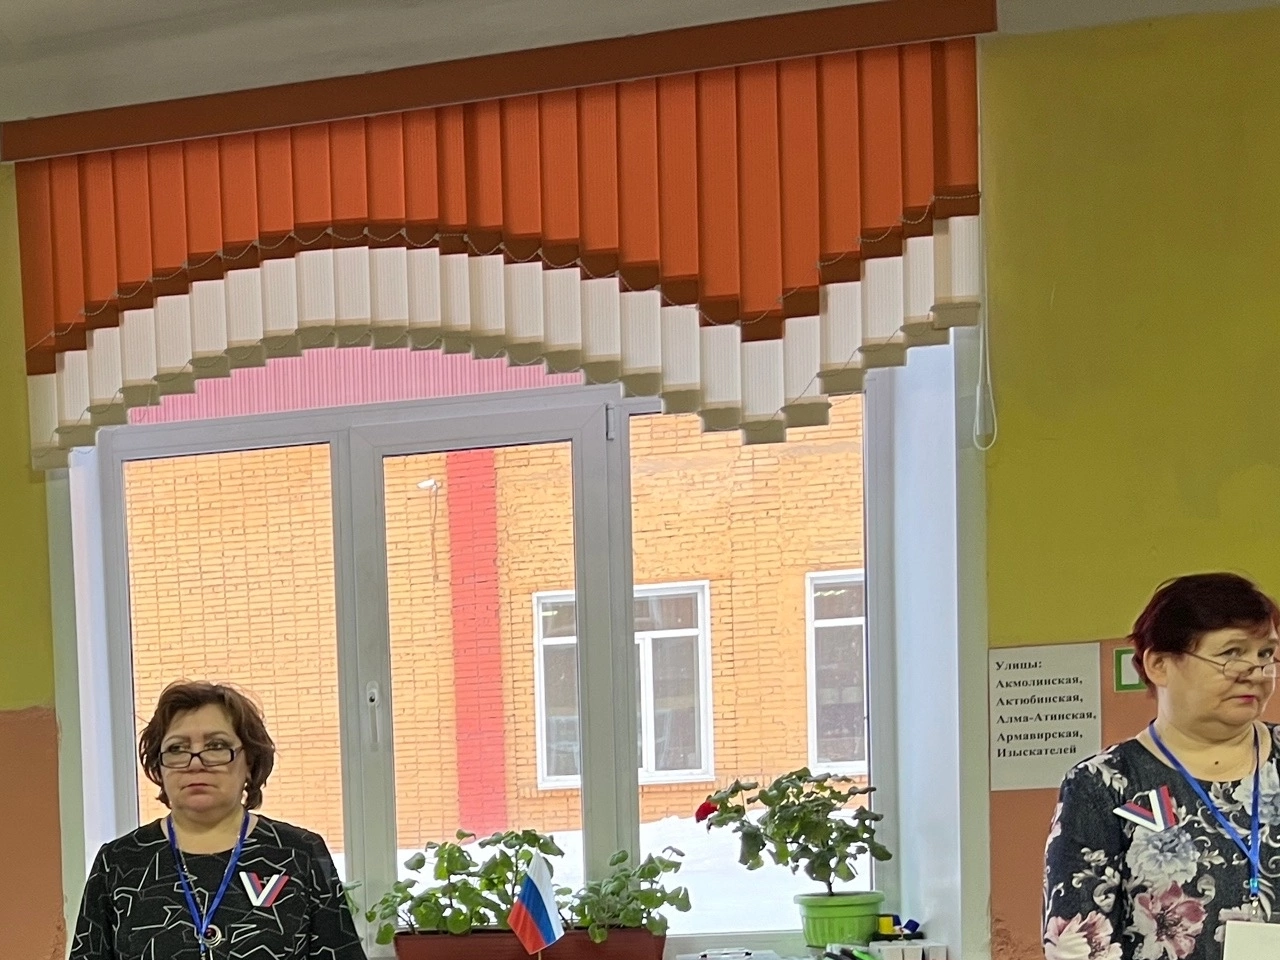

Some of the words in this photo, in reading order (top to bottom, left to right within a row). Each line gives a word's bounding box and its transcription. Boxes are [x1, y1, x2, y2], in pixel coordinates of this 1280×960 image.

[995, 661, 1042, 671] Улицы:
[996, 676, 1083, 688] Акмолинская,
[996, 695, 1083, 706] Актюбинская,
[997, 712, 1097, 724] Алма-Атинская,
[997, 730, 1083, 743] Армавирская,
[997, 745, 1077, 757] Изыскателей
